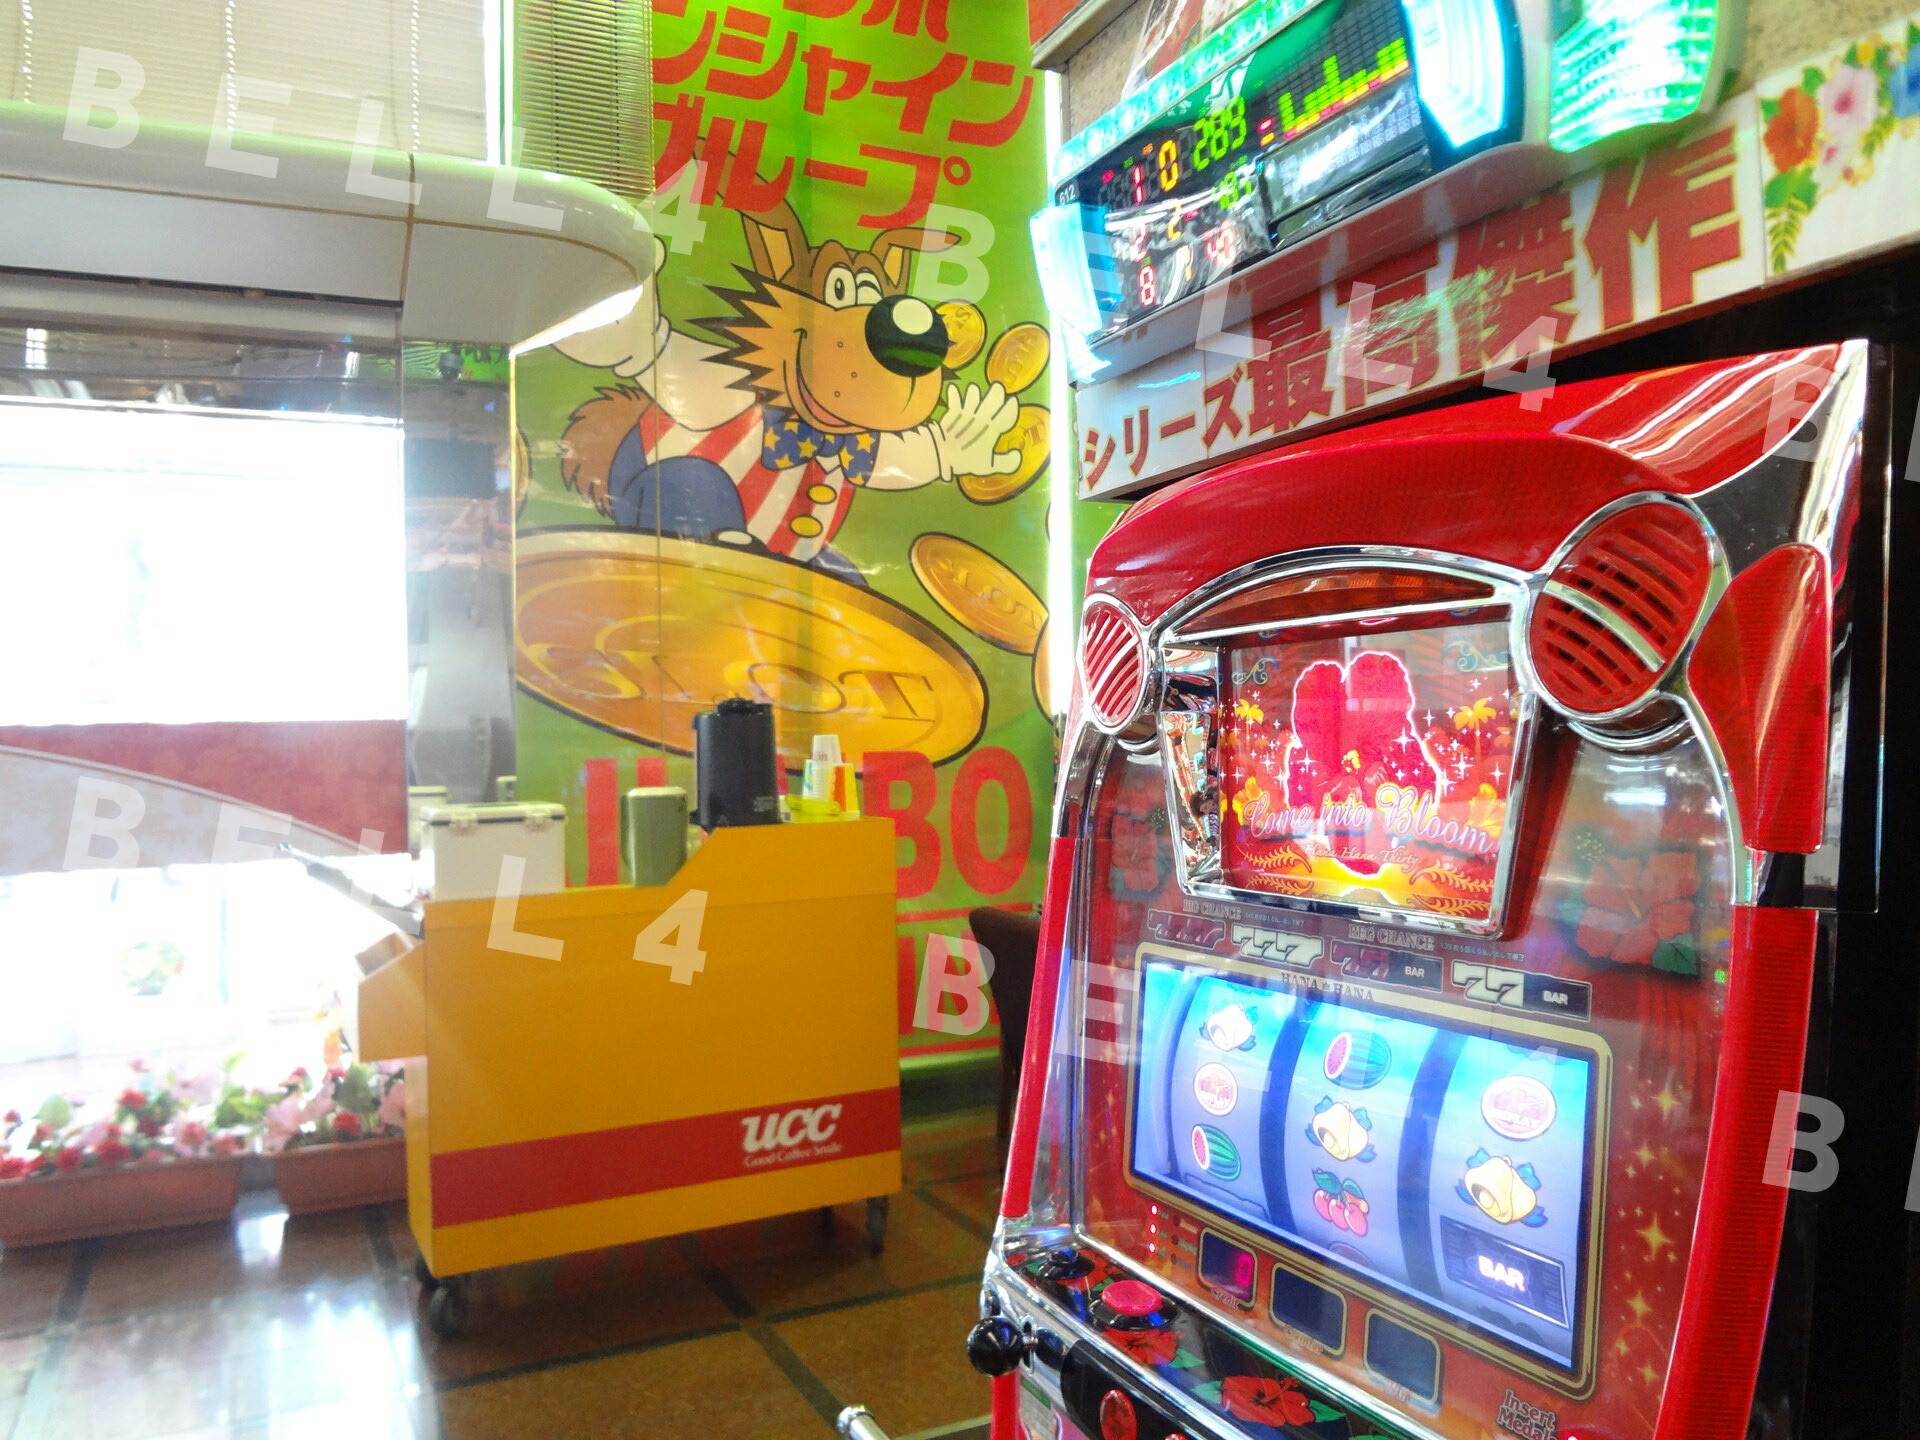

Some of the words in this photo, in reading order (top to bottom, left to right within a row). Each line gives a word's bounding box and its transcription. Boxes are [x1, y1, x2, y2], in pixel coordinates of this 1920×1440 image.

[1158, 140, 1179, 192] 0
[1193, 95, 1247, 172] 289
[1058, 184, 1077, 206] 612
[1244, 792, 1312, 838] Come
[1315, 792, 1374, 829] into
[1376, 783, 1494, 854] Bloom
[1231, 923, 1325, 969] 777
[1348, 924, 1375, 941] REG
[1377, 927, 1436, 951] CHANCE
[1281, 972, 1319, 991] HANA
[1332, 983, 1374, 1002] HANA
[1404, 966, 1425, 978] BAR
[1543, 990, 1569, 1006] BAR
[1478, 1255, 1526, 1292] BAR
[1503, 1389, 1556, 1432] Insert
